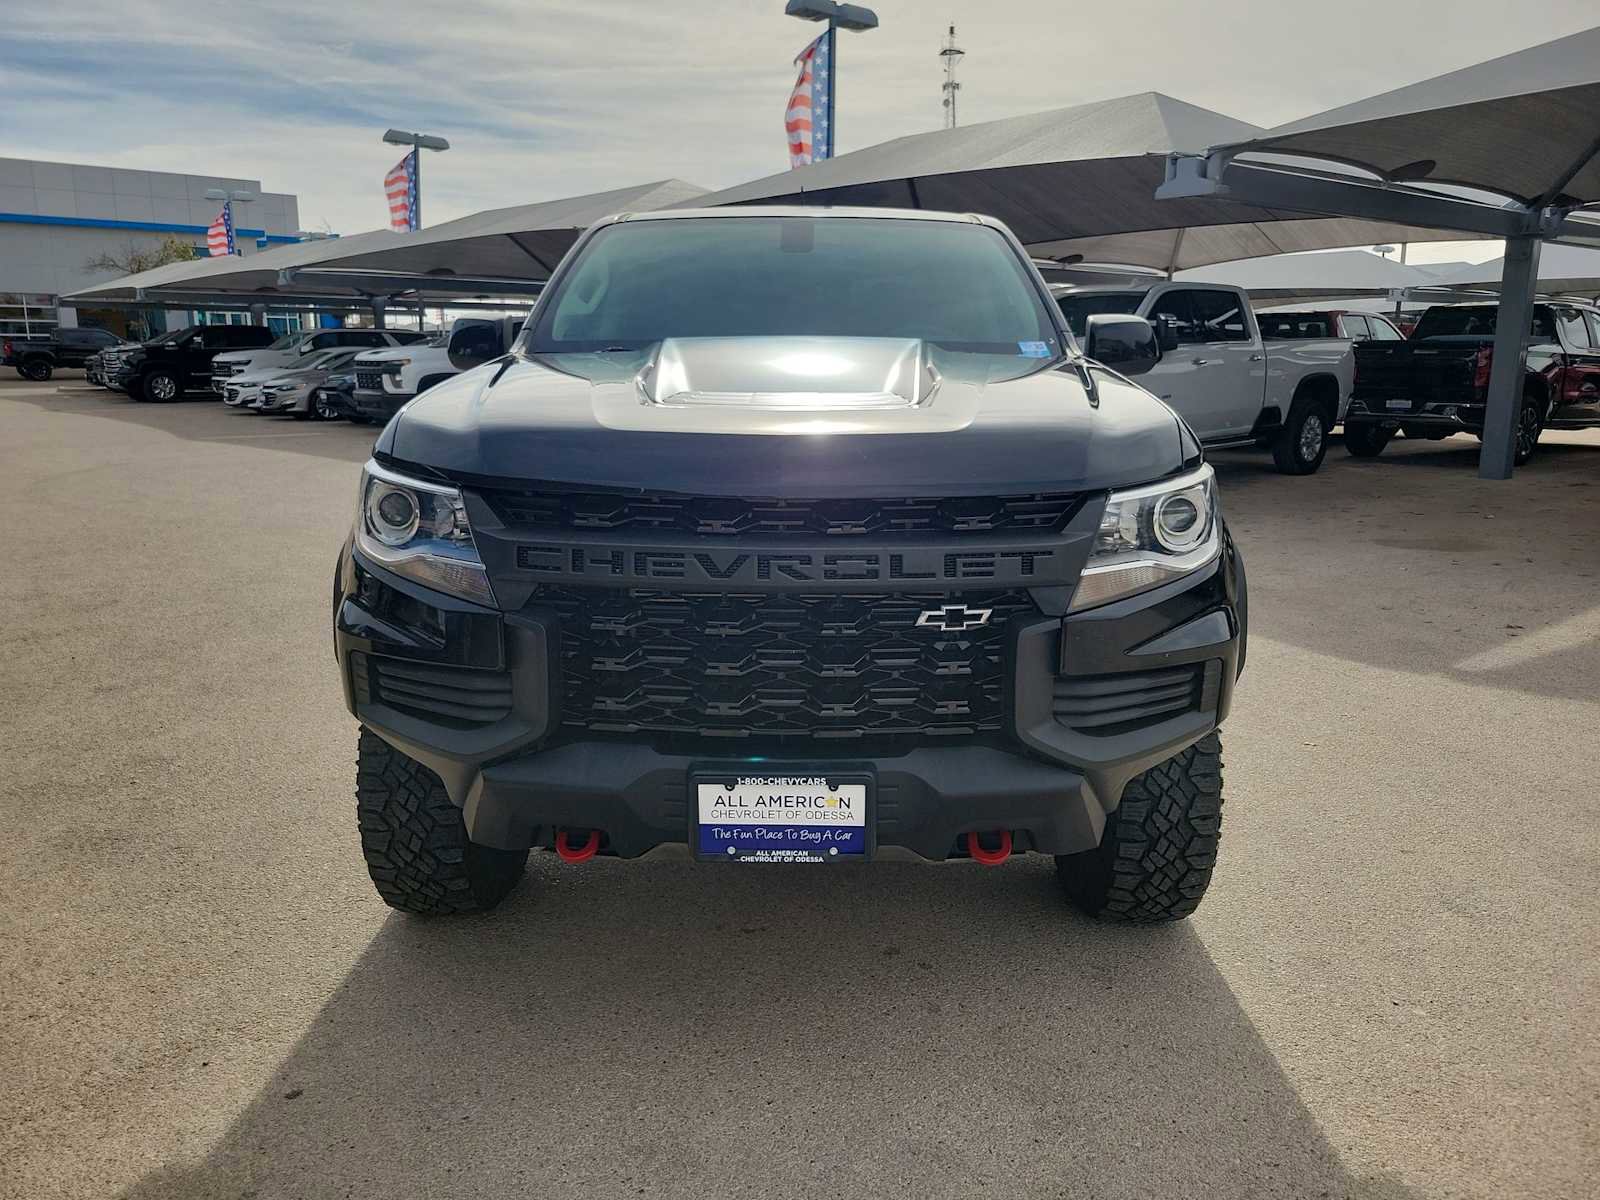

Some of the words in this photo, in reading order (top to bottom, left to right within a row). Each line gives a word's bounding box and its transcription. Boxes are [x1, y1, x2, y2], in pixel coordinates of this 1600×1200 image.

[516, 546, 1054, 580] CHEVROLET
[736, 777, 827, 786] 1-800-CHEVYCARS
[714, 795, 749, 807] ALL
[755, 795, 851, 809] AMERICN
[711, 809, 782, 819] CHEVROLET
[785, 810, 801, 820] OF
[805, 811, 854, 821] ODESSA
[711, 827, 732, 839] The
[733, 828, 753, 839] Fun
[755, 827, 784, 840] Place
[784, 828, 798, 840] To
[800, 829, 821, 844] Buy
[822, 830, 832, 841] A
[834, 830, 853, 841] Car
[740, 855, 782, 863] CHEVROLET
